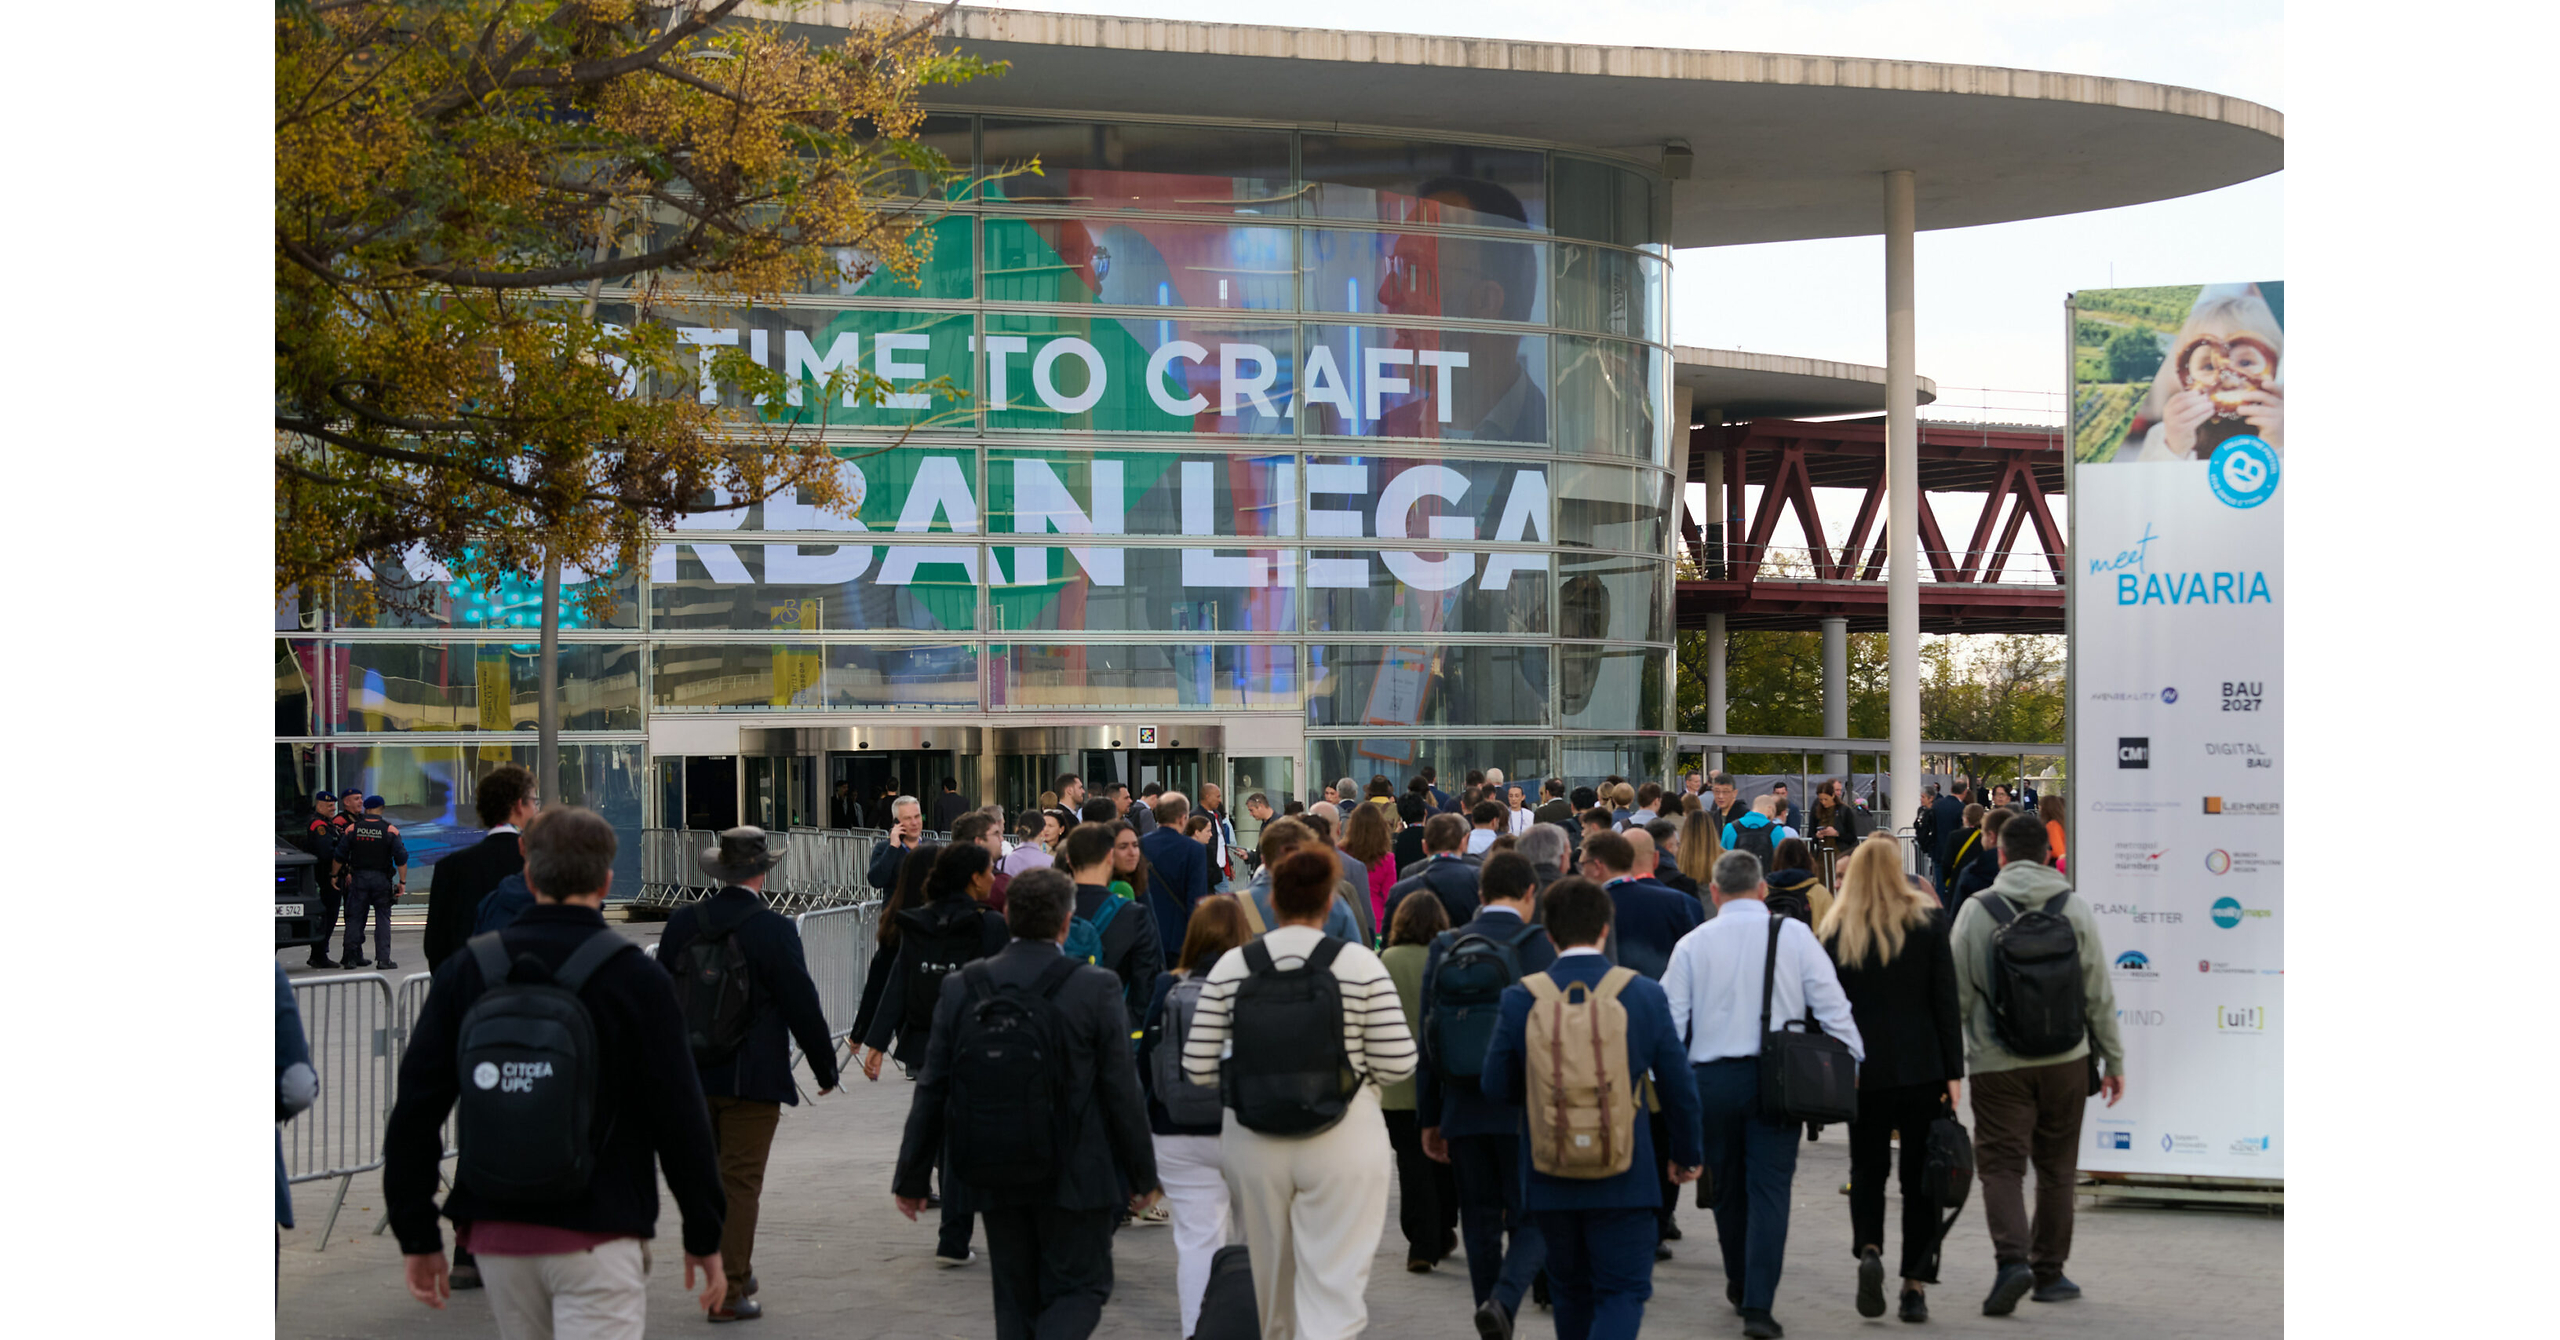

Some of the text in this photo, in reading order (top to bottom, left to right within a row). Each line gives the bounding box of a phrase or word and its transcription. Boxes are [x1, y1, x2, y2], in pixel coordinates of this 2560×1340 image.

[676, 327, 931, 410] TIME
[968, 335, 1107, 414] TO
[1145, 340, 1469, 422] CRAFT
[2090, 522, 2159, 575] meet
[2118, 571, 2272, 606] BAVARIA
[2222, 682, 2264, 697] BAU
[2221, 699, 2262, 711] 2027
[2205, 743, 2266, 755] DIGITAL
[2247, 758, 2272, 768] BAU
[2222, 802, 2280, 811] LEHNER
[286, 905, 301, 915] 5742
[2116, 1009, 2165, 1026] IIND
[502, 1062, 554, 1079] CITCEA
[501, 1078, 534, 1093] UPC
